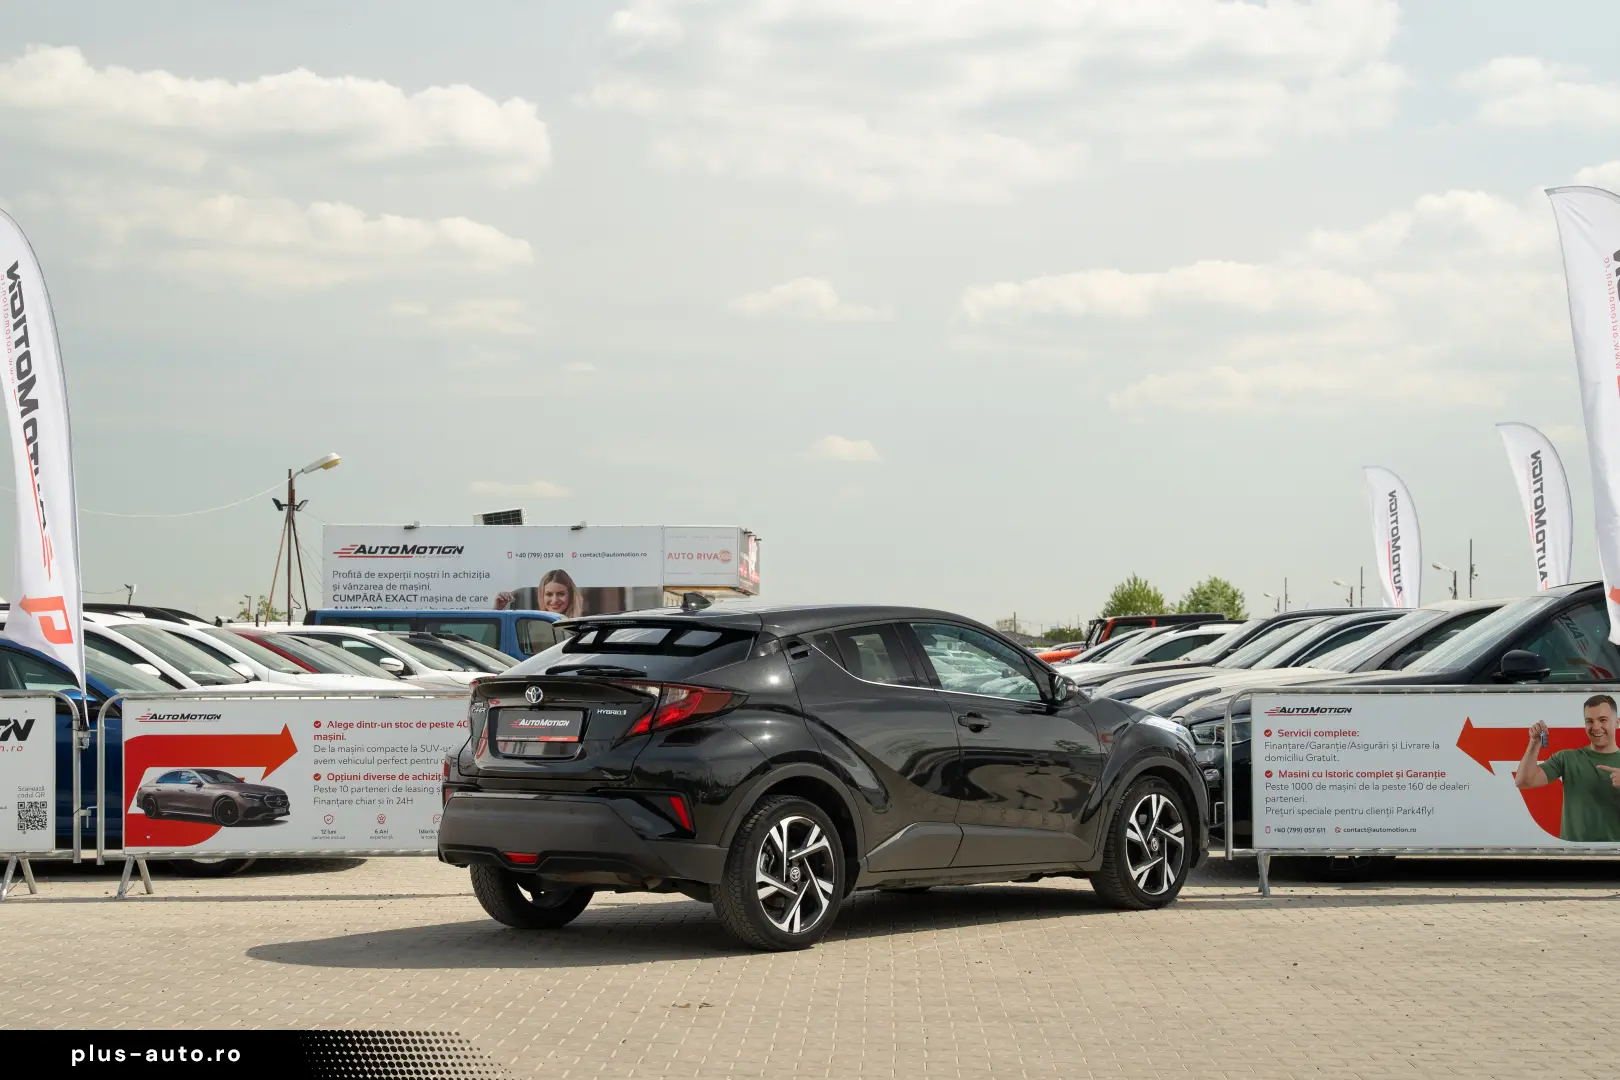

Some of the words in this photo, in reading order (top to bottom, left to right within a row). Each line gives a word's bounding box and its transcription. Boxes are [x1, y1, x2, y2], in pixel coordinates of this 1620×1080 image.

[365, 570, 375, 578] de
[414, 570, 439, 580] noștri
[453, 570, 490, 580] achiziția
[332, 582, 340, 592] și
[386, 582, 397, 590] de
[400, 583, 432, 592] mașini.
[333, 594, 382, 602] CUMPĂRĂ
[420, 595, 453, 604] mașina
[327, 721, 354, 730] Alege
[430, 721, 454, 729] peste
[314, 733, 346, 742] mașini.
[1314, 729, 1360, 739] complete:
[338, 745, 364, 754] mașini
[367, 746, 408, 754] compacte
[1392, 742, 1397, 752] și
[338, 756, 375, 764] vehiculul
[377, 756, 408, 766] perfect
[410, 757, 439, 766] pentru
[327, 773, 360, 782] Opțiuni
[1325, 770, 1353, 778] Istoric
[1356, 770, 1393, 780] complet
[1396, 770, 1403, 780] și
[1406, 770, 1446, 780] Garanție
[351, 785, 389, 794] parteneri
[405, 785, 434, 794] leasing
[1329, 782, 1356, 792] mașini
[1382, 784, 1406, 792] peste
[314, 797, 353, 807] Finanțare
[1265, 795, 1307, 804] parteneri.
[1266, 807, 1295, 818] Prețuri
[1297, 807, 1332, 817] speciale
[1335, 808, 1364, 816] pentru
[1366, 807, 1394, 817] clienții
[1397, 807, 1434, 817] Park4fly!
